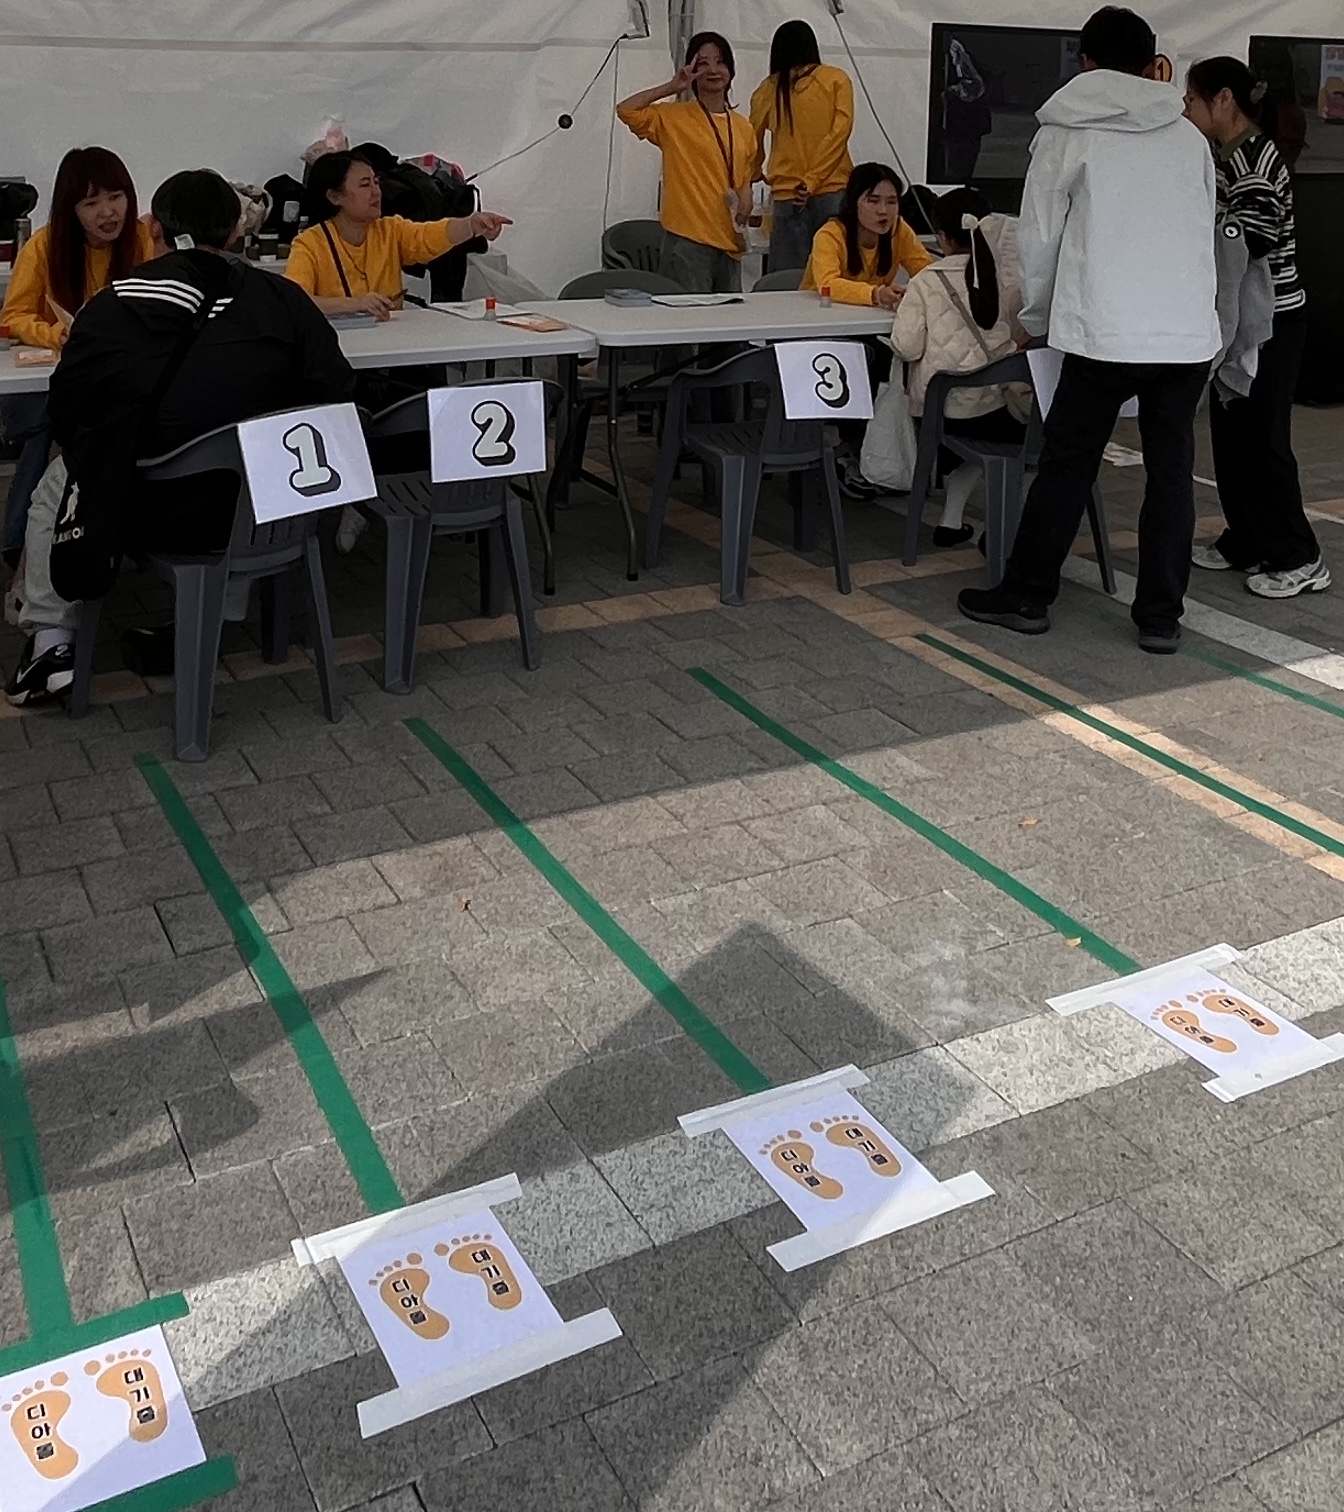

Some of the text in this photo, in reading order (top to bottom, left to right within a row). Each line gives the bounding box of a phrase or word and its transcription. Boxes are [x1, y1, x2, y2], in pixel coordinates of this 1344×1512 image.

[811, 351, 851, 410] 3
[280, 422, 343, 498] 1
[469, 399, 517, 467] 2
